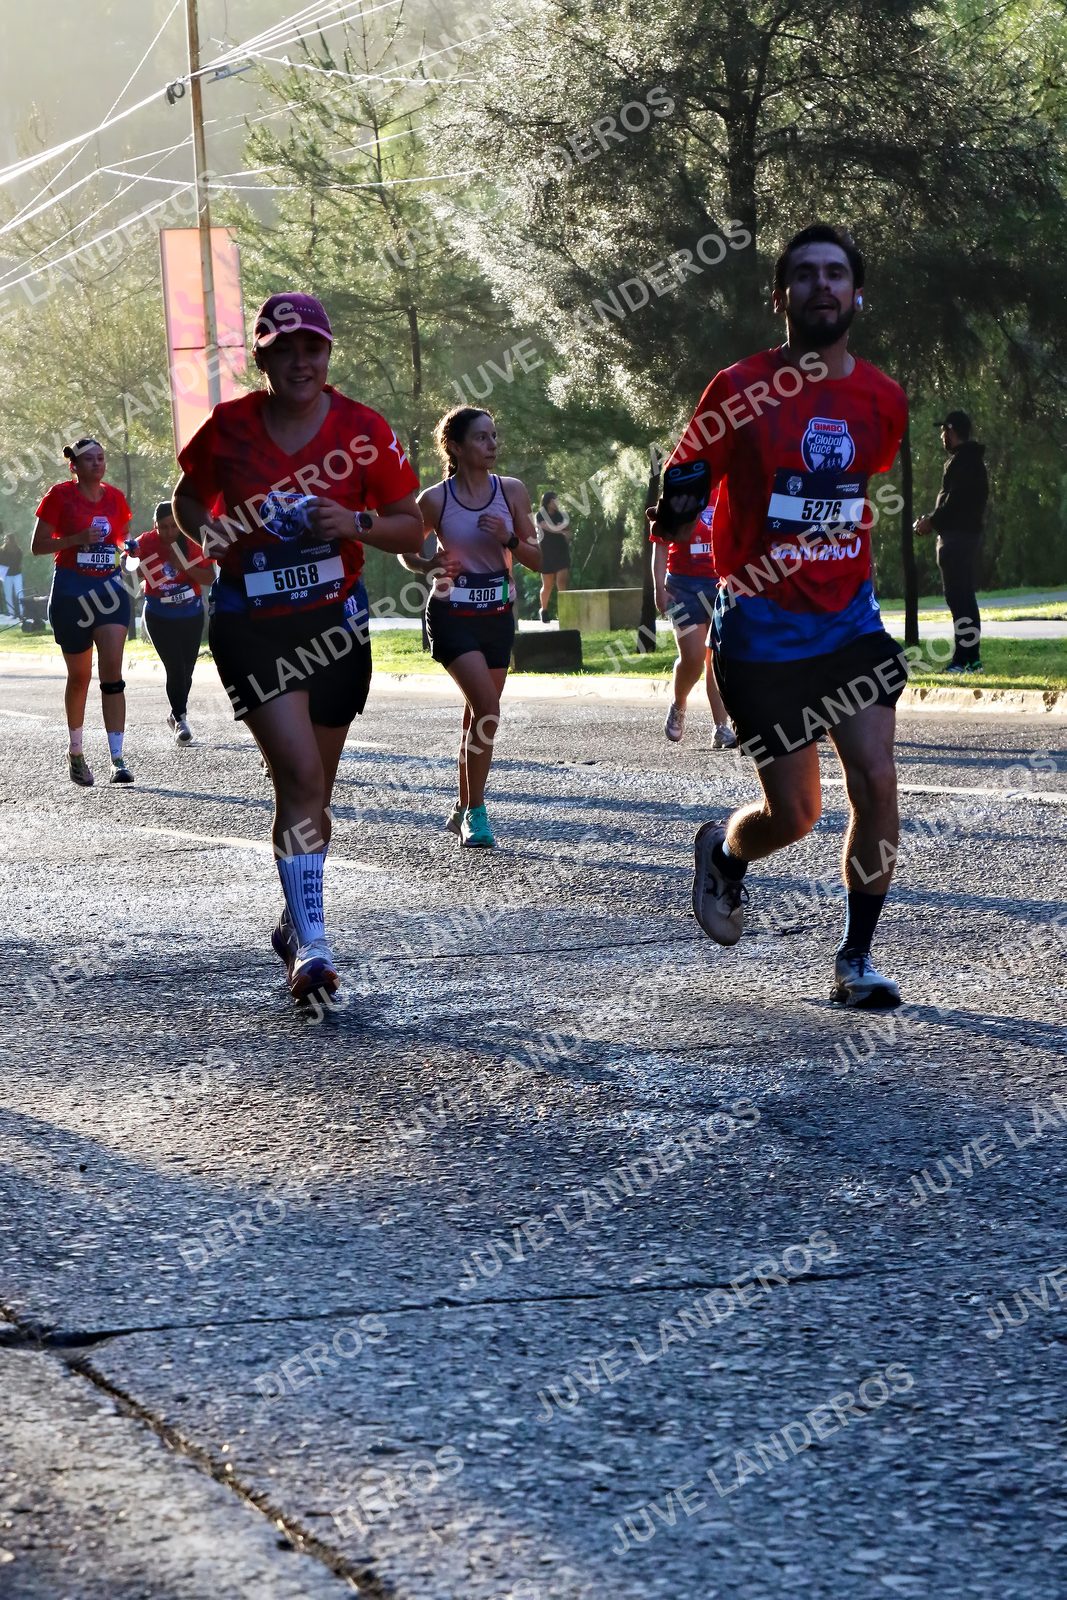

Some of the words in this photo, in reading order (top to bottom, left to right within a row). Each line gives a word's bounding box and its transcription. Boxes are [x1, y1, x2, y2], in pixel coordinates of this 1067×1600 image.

[814, 423, 843, 433] BIMBO
[815, 434, 843, 447] Global
[809, 443, 832, 455] Race
[801, 500, 842, 520] 5276
[90, 554, 111, 564] 4036
[272, 564, 319, 591] 5068
[325, 591, 340, 600] 10K
[468, 588, 496, 601] 4308
